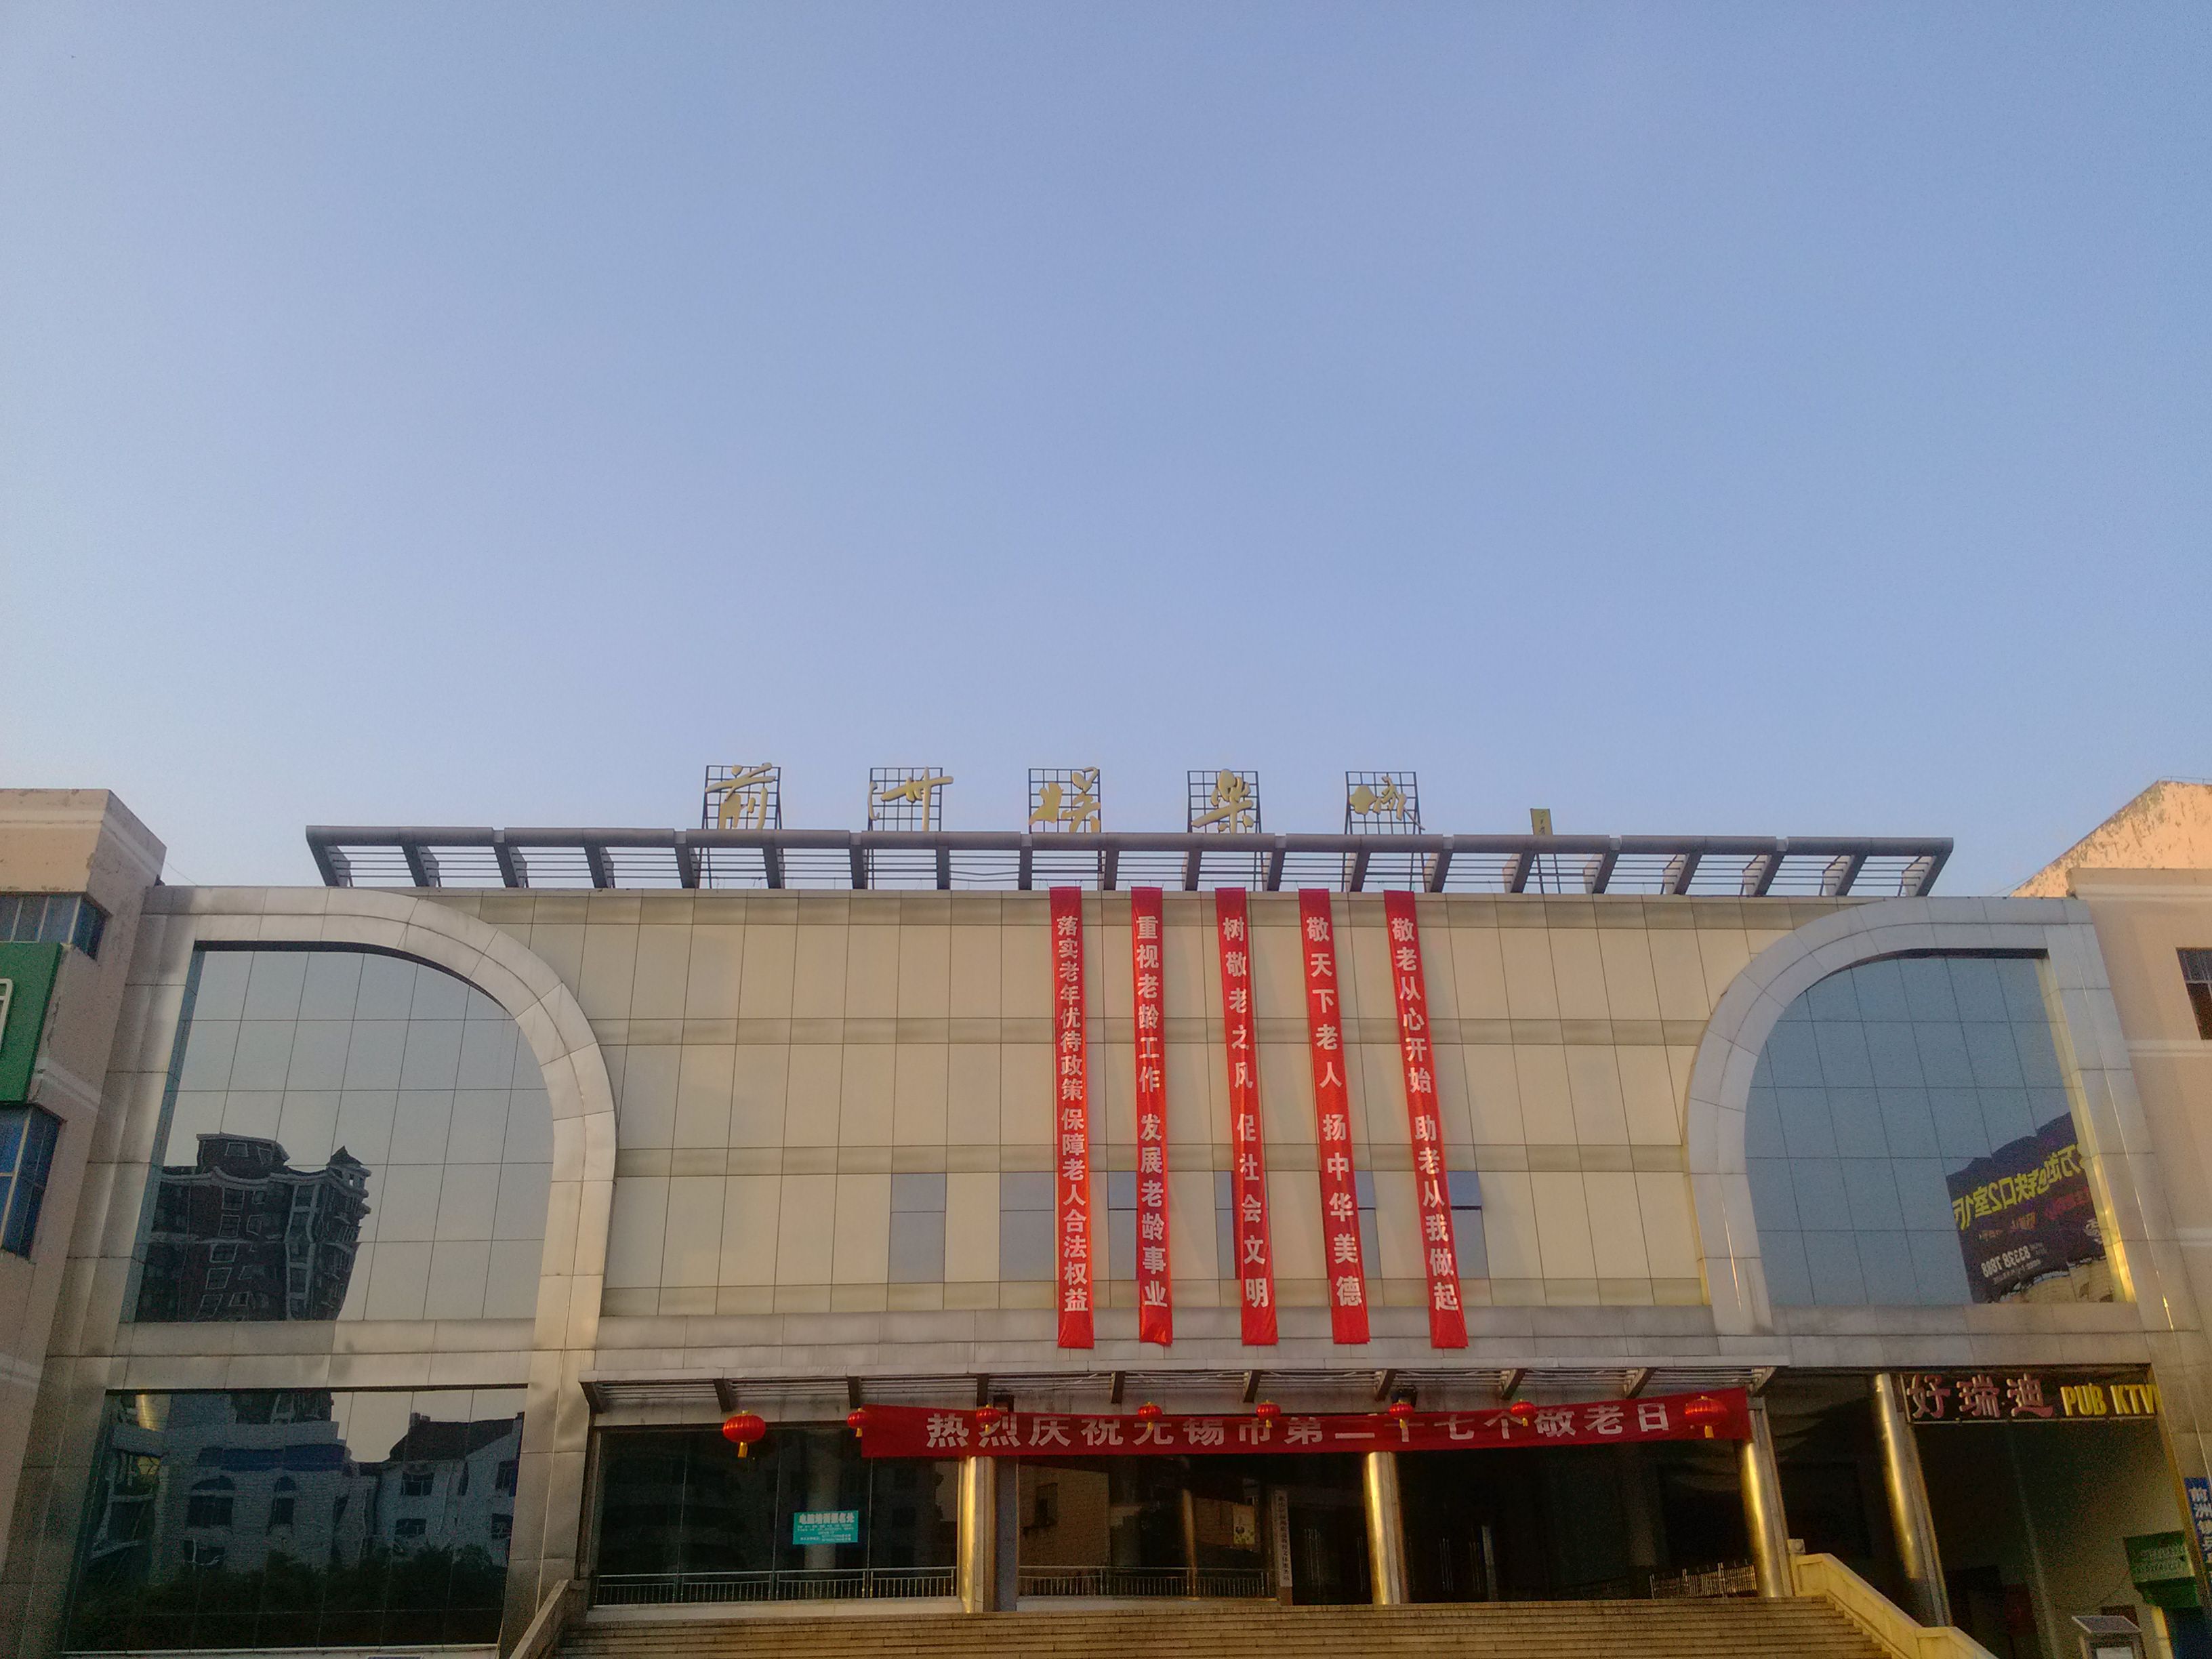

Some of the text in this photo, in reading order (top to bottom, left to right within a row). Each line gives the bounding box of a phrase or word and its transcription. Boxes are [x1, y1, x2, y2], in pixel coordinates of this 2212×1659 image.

[1057, 916, 1088, 1313] 落实老年优待政策 保障老人合法权益
[1136, 916, 1168, 1307] 重视老龄工作 发展老龄事业
[1223, 917, 1269, 1309] 树敬老之风 促社会文明
[1307, 917, 1362, 1307] 敬天下老人 扬中华美德
[1392, 918, 1458, 1312] 敬老从心开始 助老从我做起
[1906, 1373, 2158, 1418] 好瑞迪 PUB KTV
